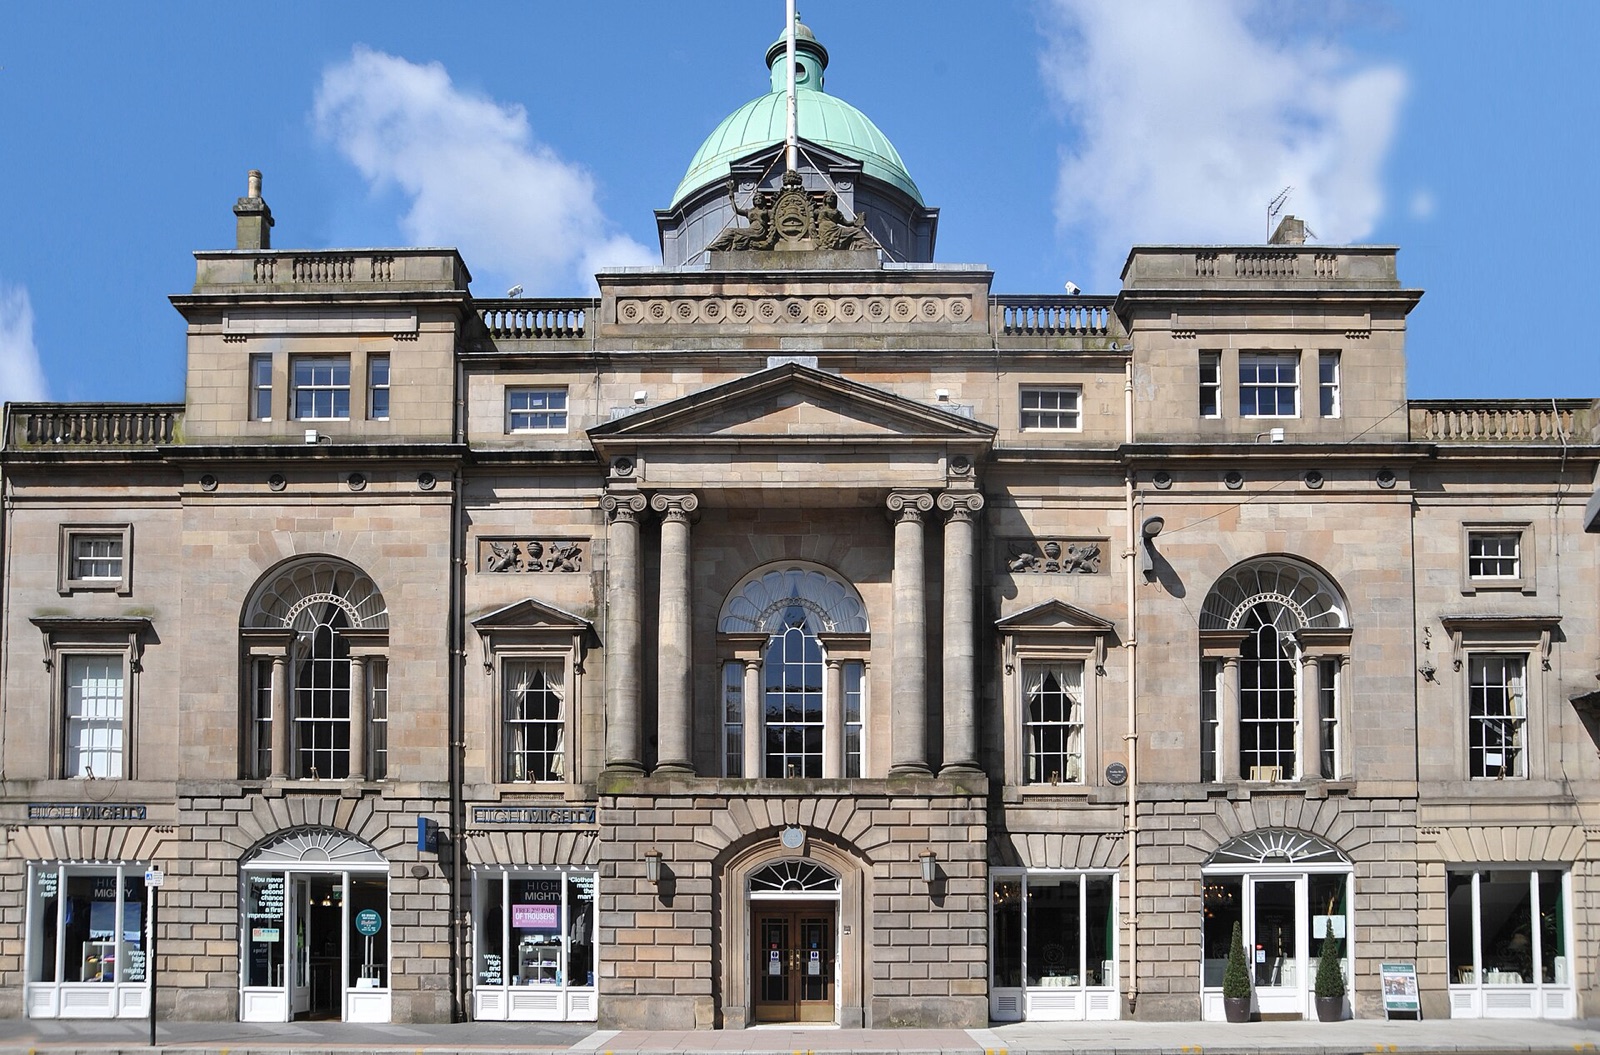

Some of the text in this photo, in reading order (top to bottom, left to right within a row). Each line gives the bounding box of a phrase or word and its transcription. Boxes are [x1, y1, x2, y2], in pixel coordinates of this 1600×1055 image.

[81, 806, 146, 819] MIGHTY
[527, 808, 595, 823] MIGHTY
[527, 881, 558, 891] HIGH
[525, 892, 562, 901] MIGHTY
[131, 955, 145, 963] high
[123, 967, 145, 975] mighty
